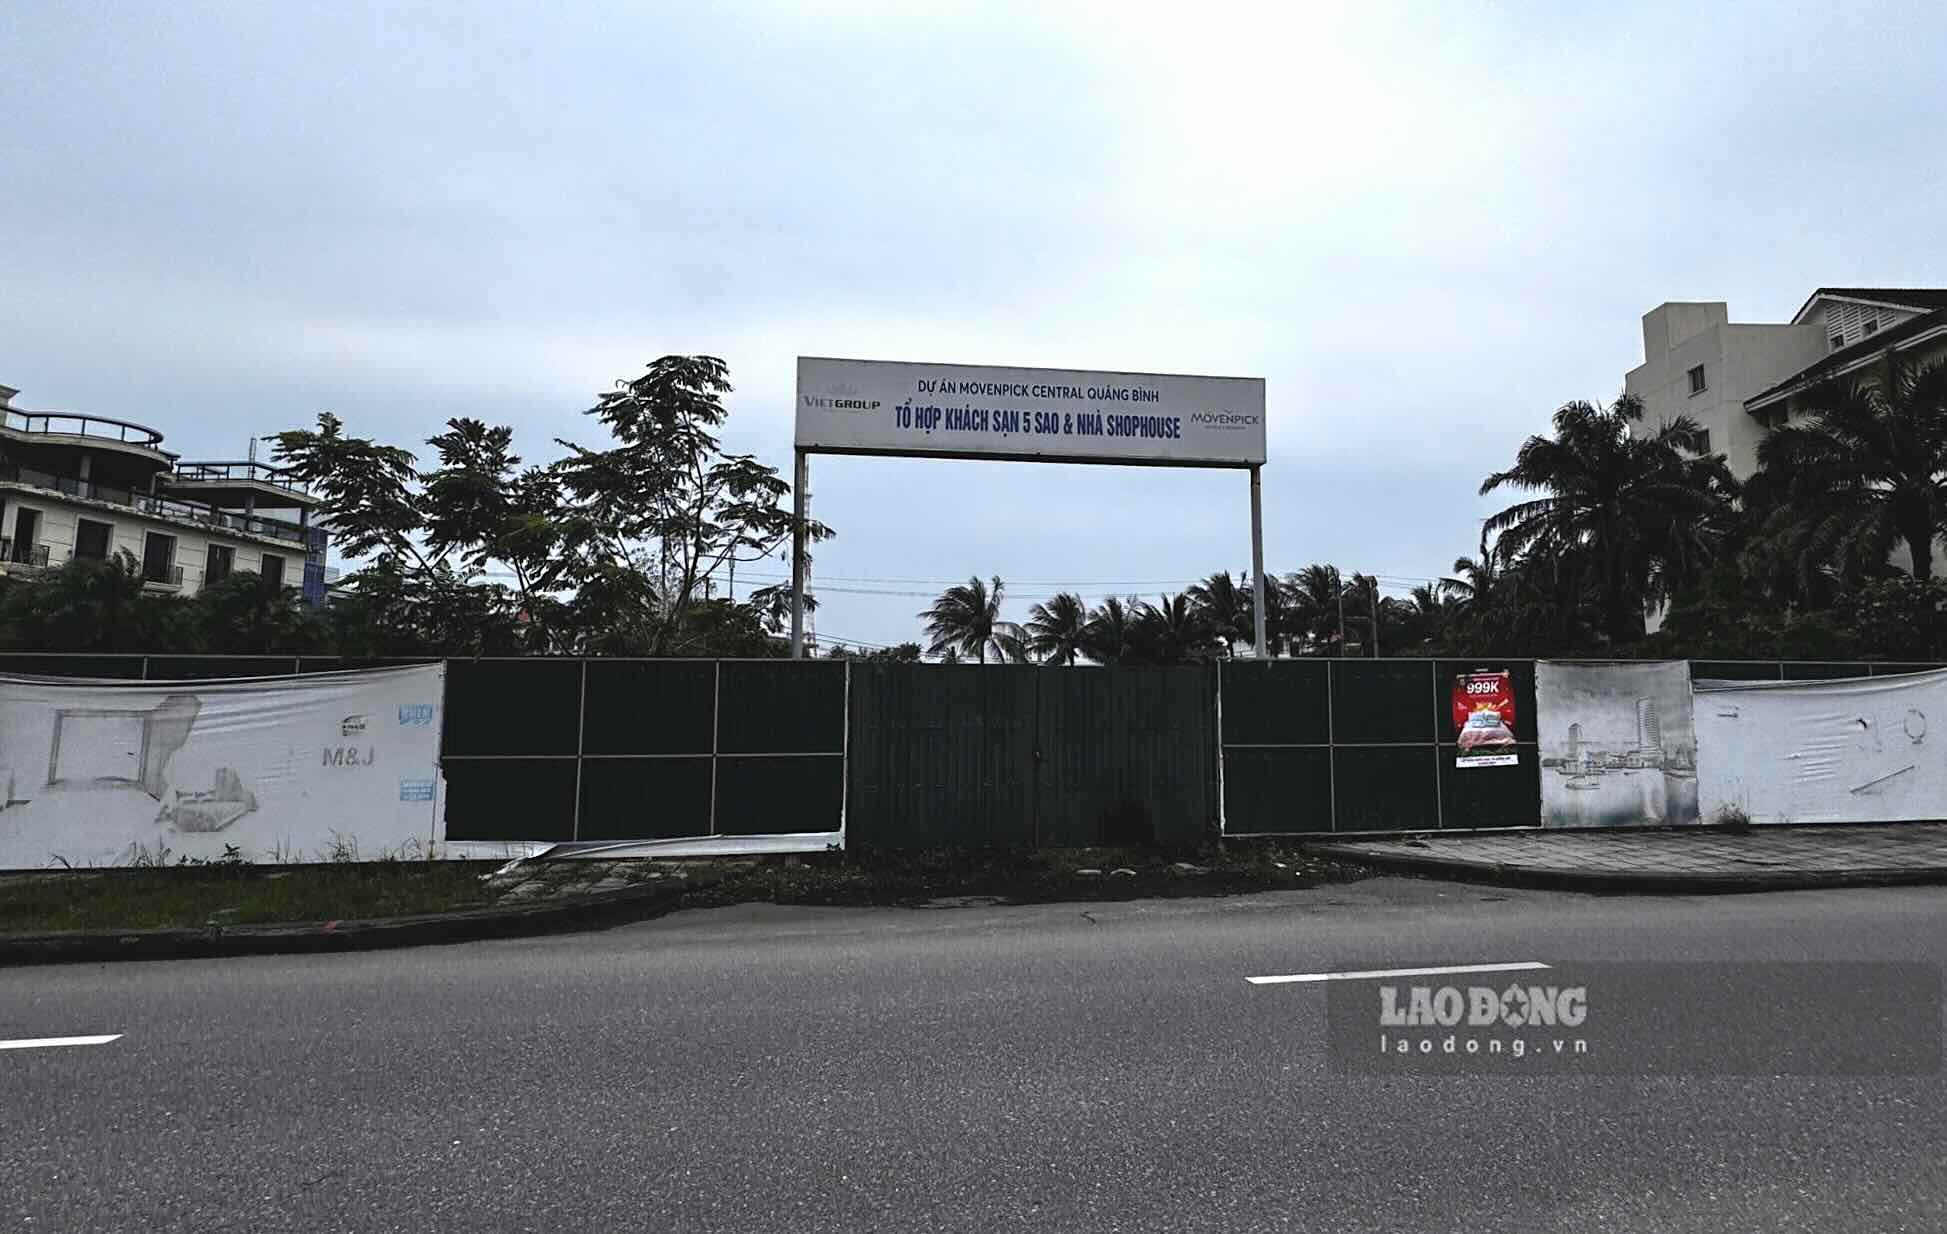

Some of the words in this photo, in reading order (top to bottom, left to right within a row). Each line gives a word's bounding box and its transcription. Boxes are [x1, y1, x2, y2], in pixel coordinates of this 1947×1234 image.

[917, 379, 937, 397] DỰ
[939, 378, 957, 394] ÁN
[959, 382, 1029, 397] MOVENPICK
[1032, 384, 1085, 400] CENTRAL
[1087, 384, 1129, 401] QUẢNG
[1132, 386, 1160, 403] BÌNH
[895, 398, 913, 429] TỔ
[914, 405, 942, 434] HỢP
[945, 404, 989, 432] KHÁCH
[992, 411, 1019, 437] SẠN
[1023, 412, 1032, 434] 5
[1034, 412, 1059, 434] SAO
[1063, 415, 1073, 434] &
[1107, 414, 1181, 439] SHOPHOUSE
[1467, 682, 1499, 694] 999K
[322, 746, 375, 767] M&J
